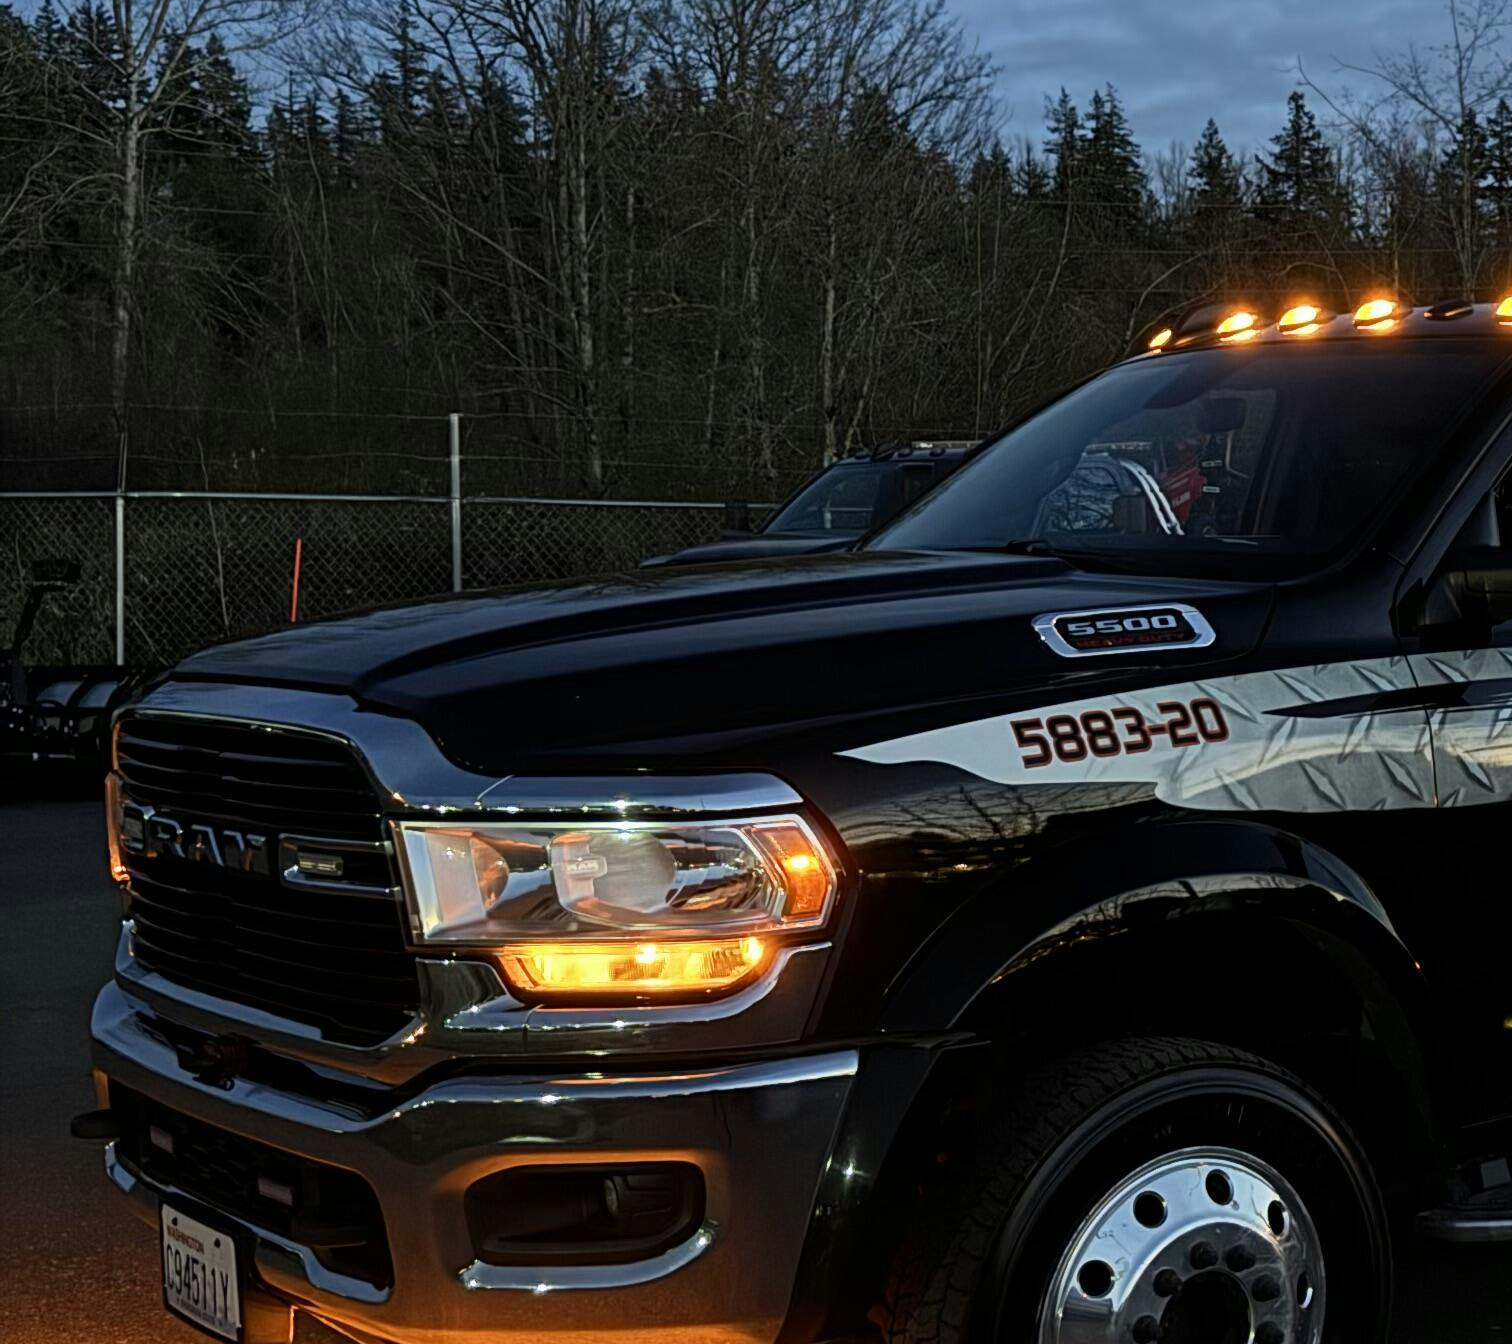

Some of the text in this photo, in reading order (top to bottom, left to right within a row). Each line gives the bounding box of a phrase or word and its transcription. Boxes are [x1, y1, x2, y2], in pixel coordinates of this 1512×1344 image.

[1067, 615, 1177, 636] 5500
[1009, 698, 1230, 769] 5883-20
[166, 1244, 229, 1321] C94511Y
